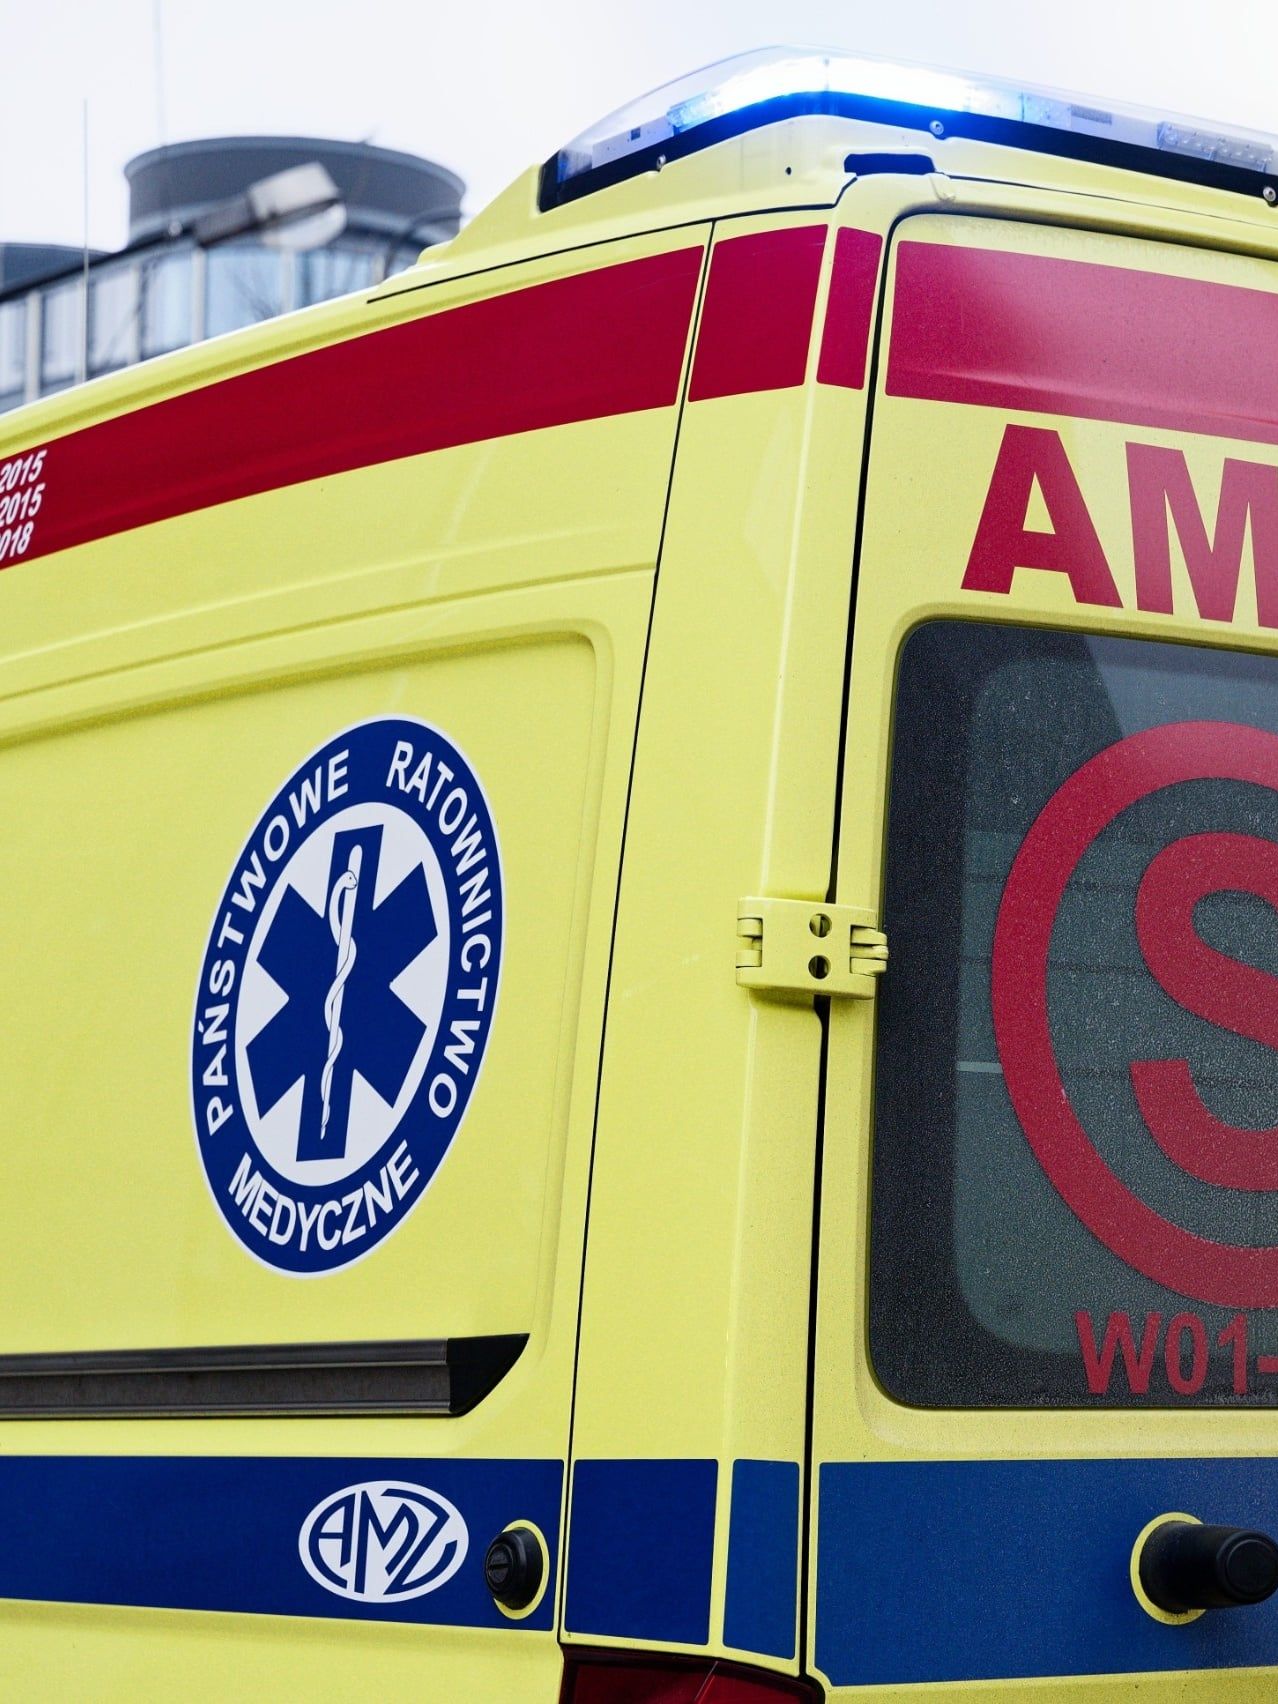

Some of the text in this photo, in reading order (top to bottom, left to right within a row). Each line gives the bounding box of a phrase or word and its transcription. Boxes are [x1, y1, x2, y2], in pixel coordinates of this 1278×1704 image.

[0, 449, 48, 493] 2015
[0, 482, 46, 528] 2015
[198, 740, 492, 1136] PAŃSTWOWE RATOWNICTWO
[228, 1140, 419, 1252] MEDYCZNE
